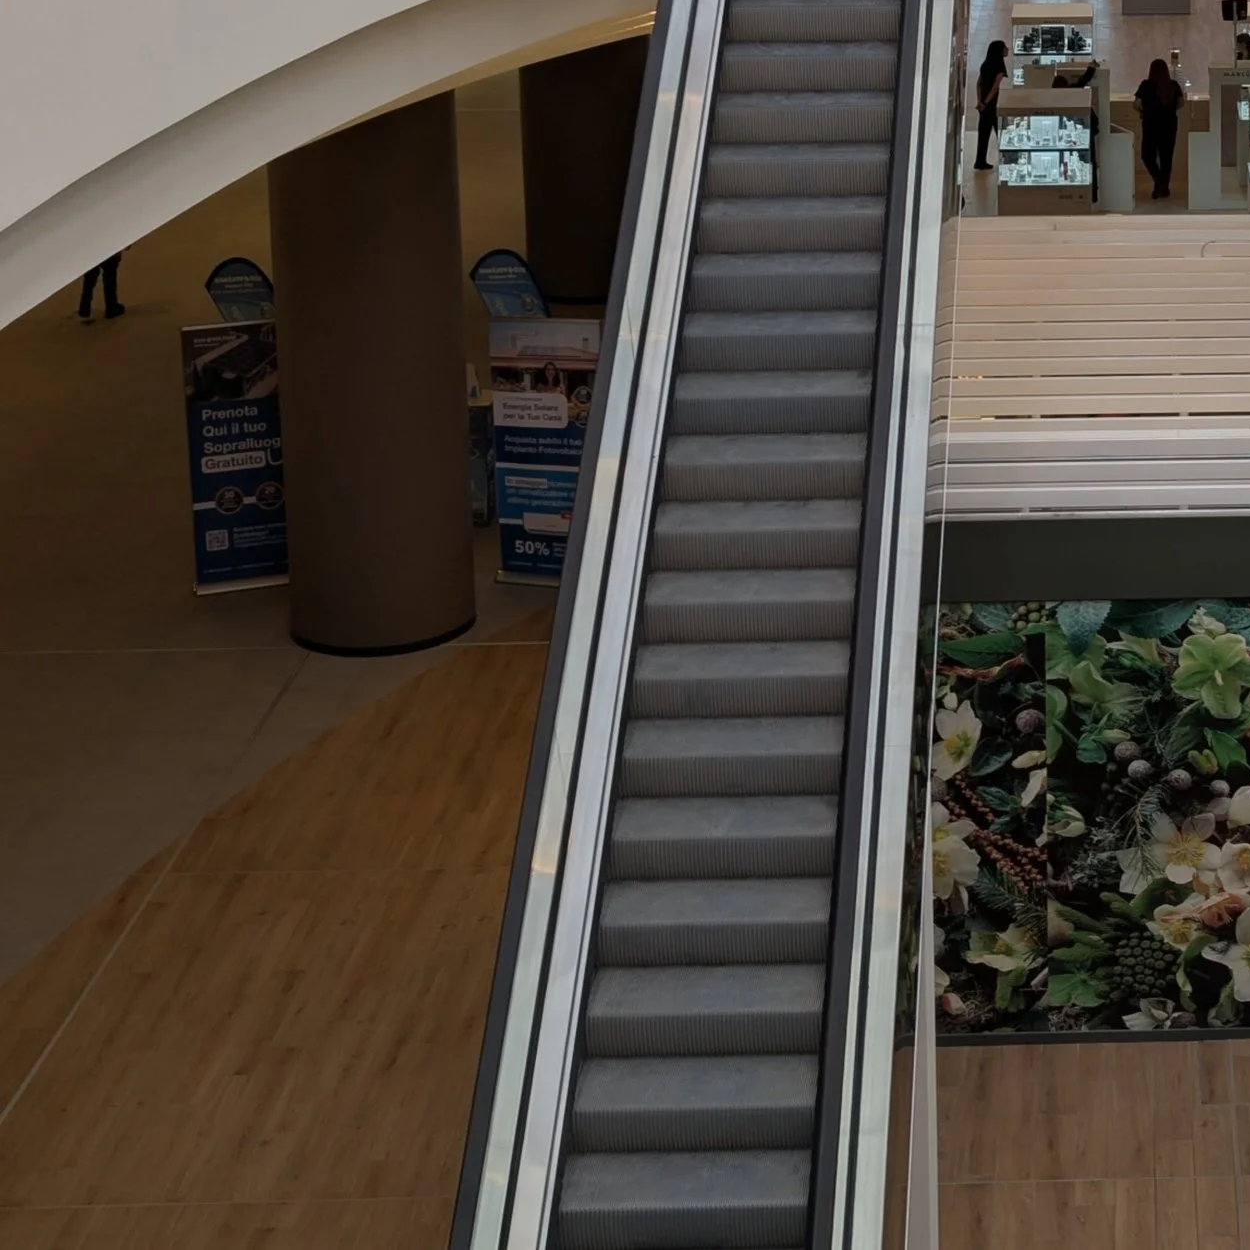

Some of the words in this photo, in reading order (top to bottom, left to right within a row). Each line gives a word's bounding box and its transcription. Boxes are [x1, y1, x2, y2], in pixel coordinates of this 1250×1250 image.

[201, 405, 259, 421] Prenota
[202, 422, 226, 437] Qui
[231, 423, 239, 435] il
[243, 421, 267, 434] tuo
[203, 437, 281, 454] Sopralluog
[205, 455, 264, 471] Gratuito
[514, 539, 550, 556] 50%
